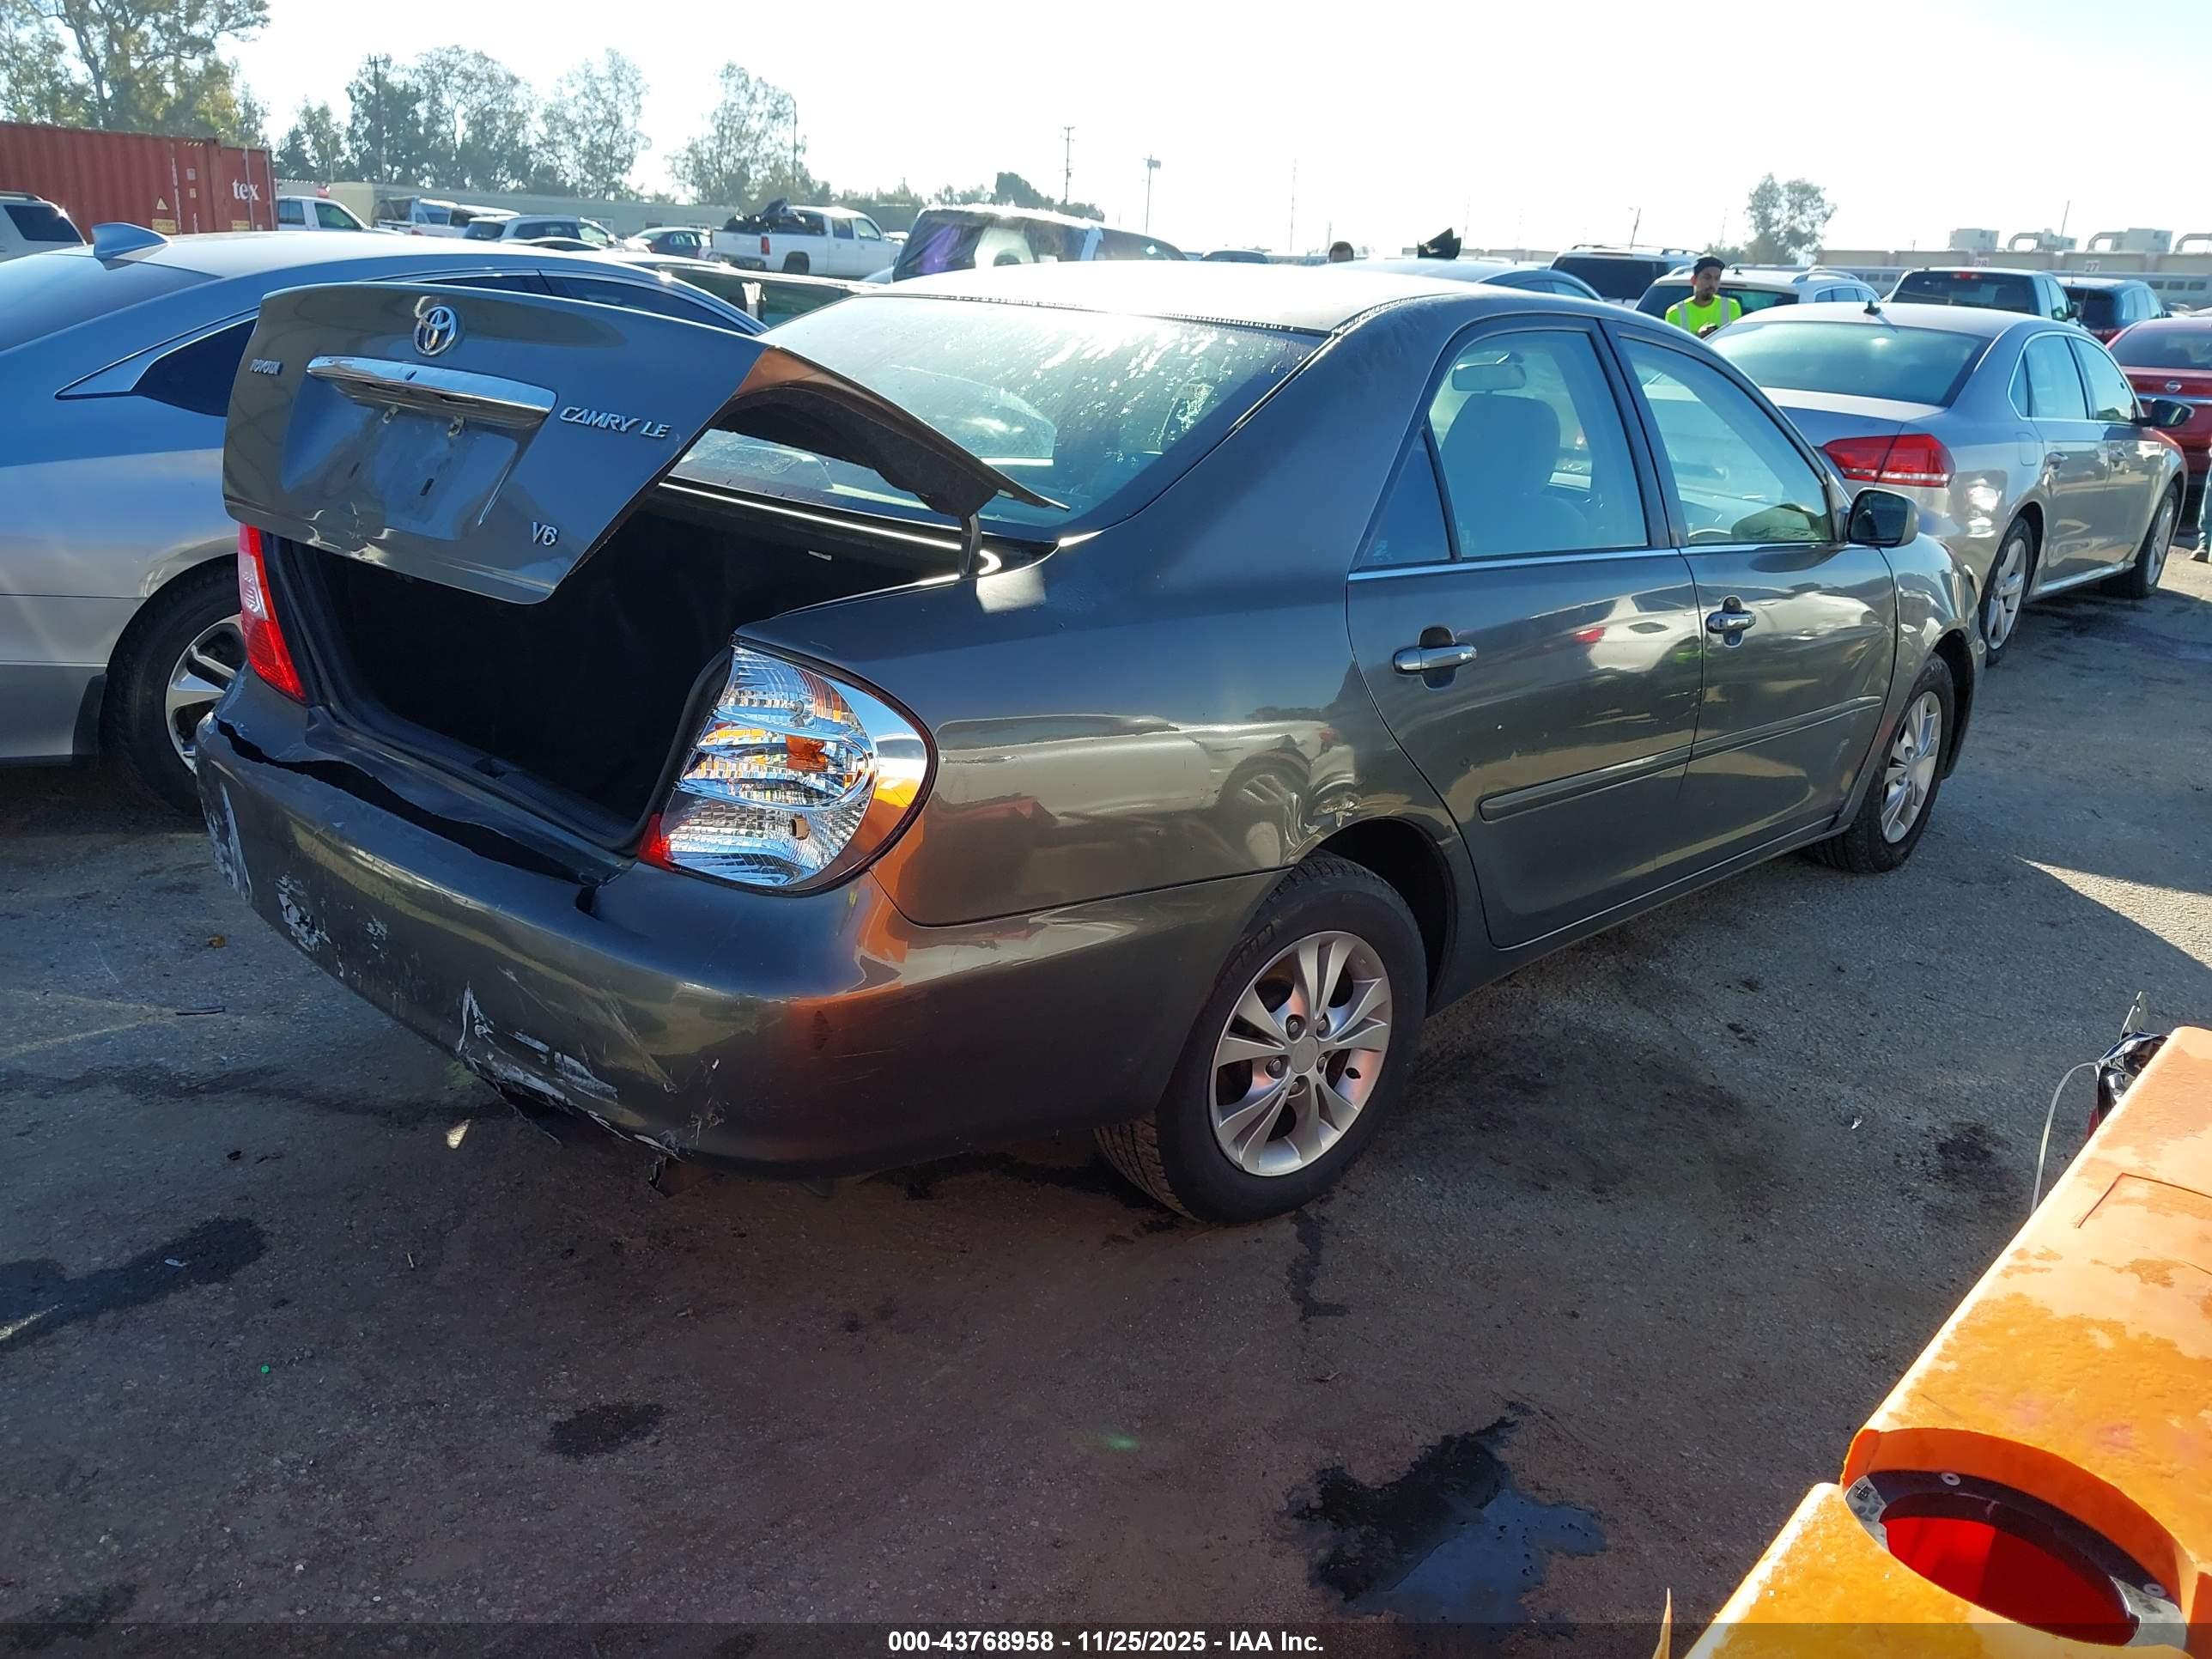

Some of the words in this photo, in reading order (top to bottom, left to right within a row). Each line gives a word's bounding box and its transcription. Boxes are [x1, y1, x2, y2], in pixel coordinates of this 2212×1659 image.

[232, 179, 260, 201] tex
[250, 359, 281, 375] TOYOTA
[559, 406, 641, 432] CAMRY
[640, 421, 672, 437] LE
[532, 521, 557, 545] V6
